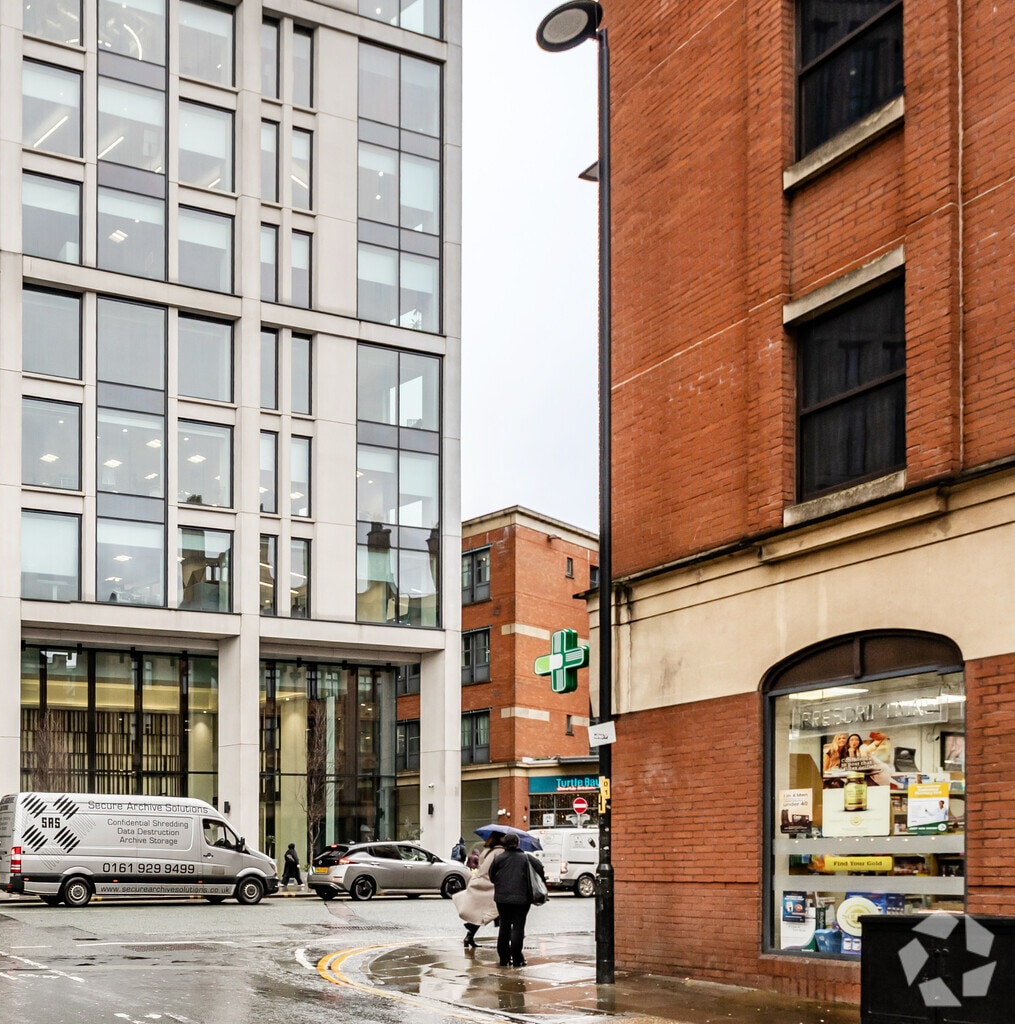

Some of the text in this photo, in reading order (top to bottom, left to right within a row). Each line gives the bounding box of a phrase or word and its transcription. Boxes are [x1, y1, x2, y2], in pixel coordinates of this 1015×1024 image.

[556, 778, 583, 787] Turtle
[88, 800, 209, 814] Secure Archive Solutions
[41, 817, 61, 828] SAS
[107, 818, 189, 829] Confidential Shredding
[137, 828, 180, 836] Destruction
[119, 836, 178, 846] Archive Storage
[102, 862, 195, 874] 0161 929 9499
[100, 885, 230, 894] www.securearchivesolutions.co.uk
